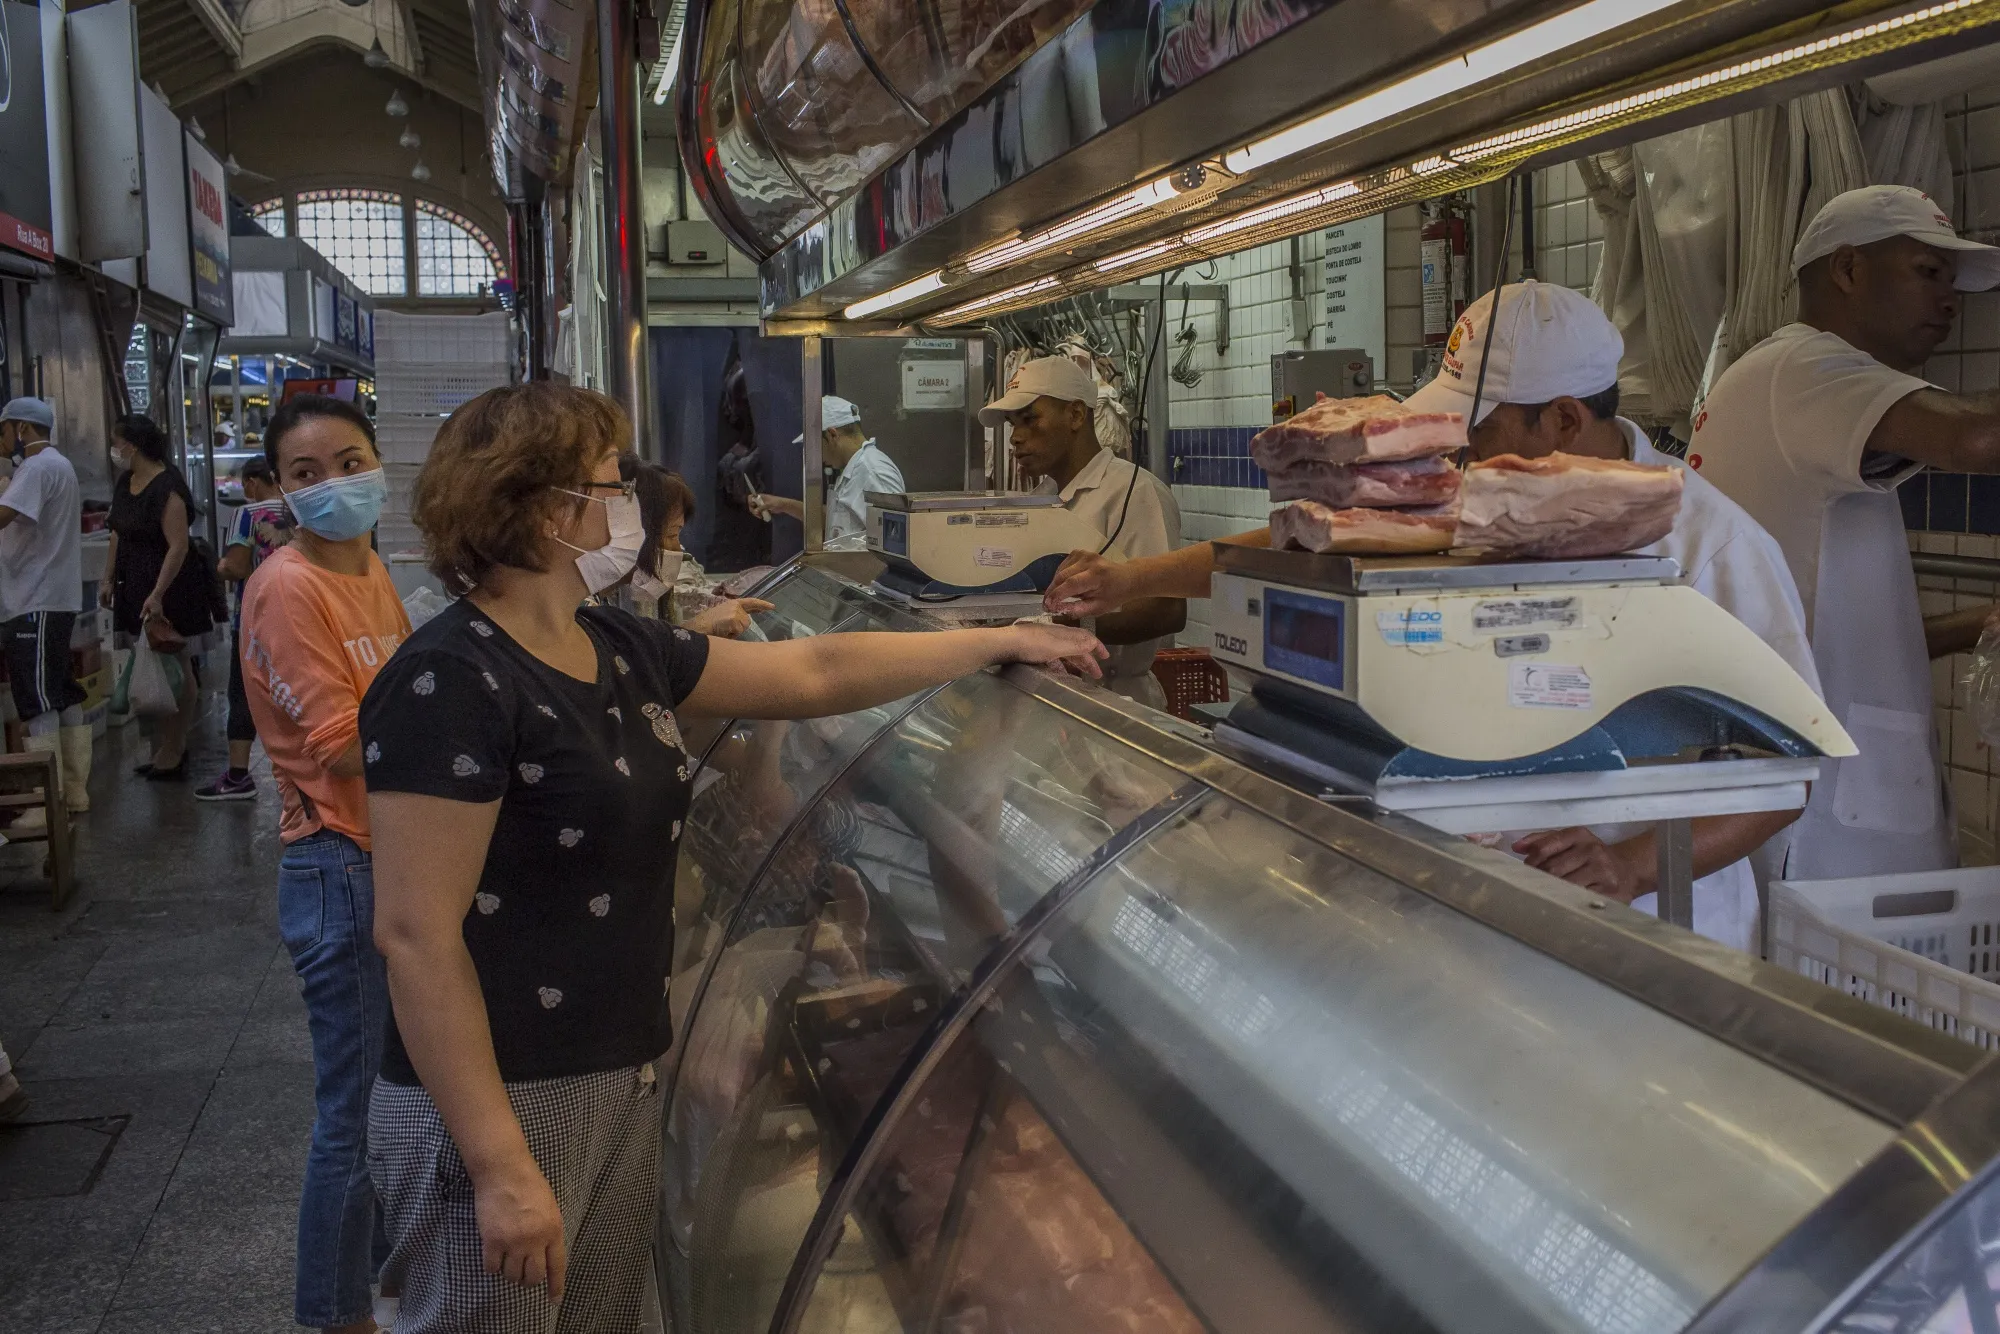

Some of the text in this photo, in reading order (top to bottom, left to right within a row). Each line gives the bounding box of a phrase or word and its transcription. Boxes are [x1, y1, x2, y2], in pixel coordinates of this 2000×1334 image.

[1326, 229, 1345, 240] PANCETA
[1325, 246, 1341, 256] BISTECA
[1348, 241, 1362, 251] LOMBO
[1326, 256, 1361, 270] PONTA DE COSTELA
[1326, 290, 1345, 300] COSTELA
[1327, 304, 1346, 314] BARRIGA
[917, 377, 950, 387] CÂMARA 2
[1214, 632, 1247, 656] TOLEDO
[343, 636, 378, 669] TO
